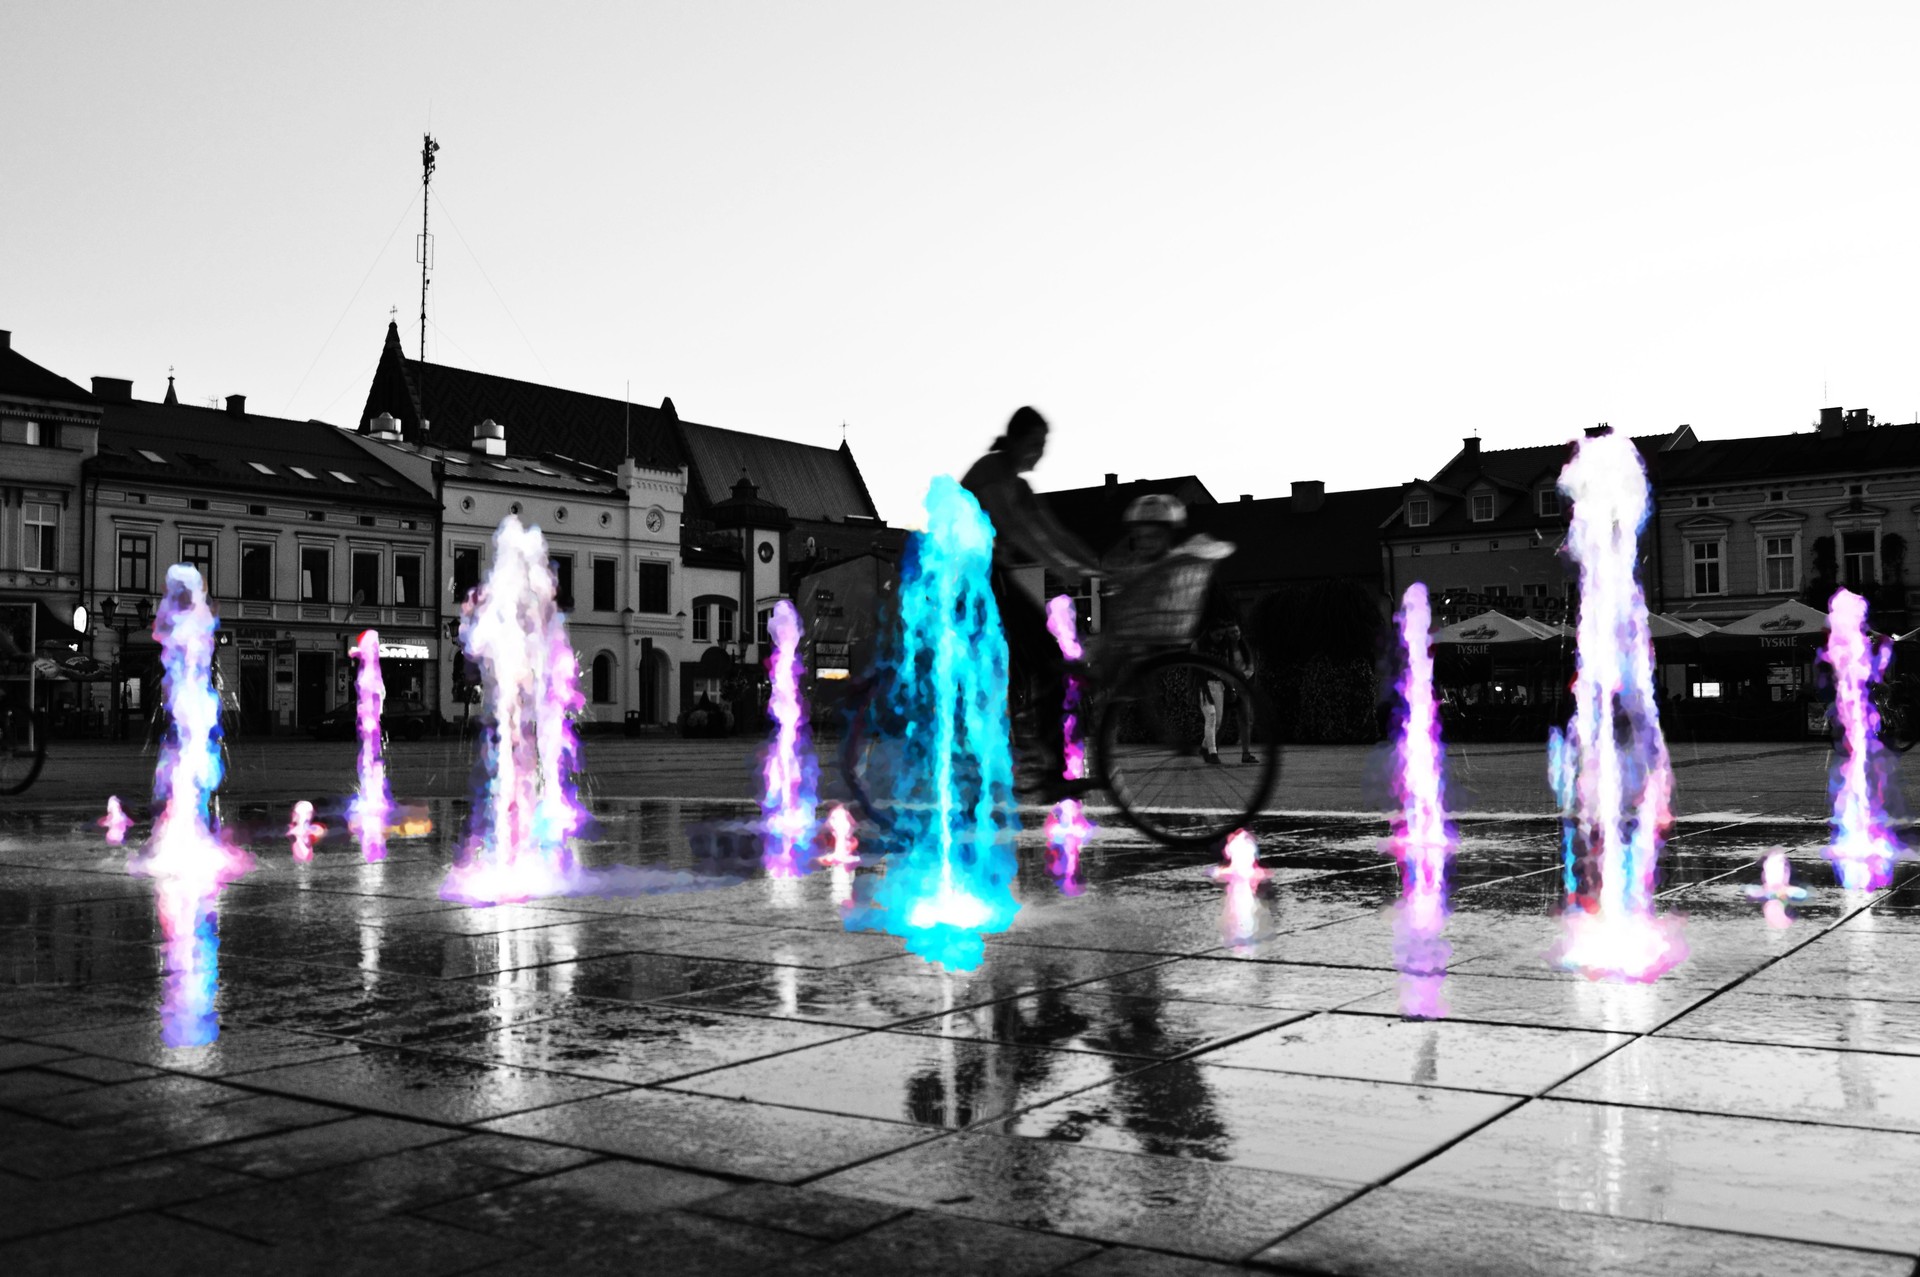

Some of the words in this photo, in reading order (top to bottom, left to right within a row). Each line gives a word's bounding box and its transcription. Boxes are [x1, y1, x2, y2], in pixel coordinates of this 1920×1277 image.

[1430, 592, 1523, 608] PRZEDAM
[1759, 636, 1798, 647] TYSKIE
[1456, 643, 1490, 655] TYSKIE
